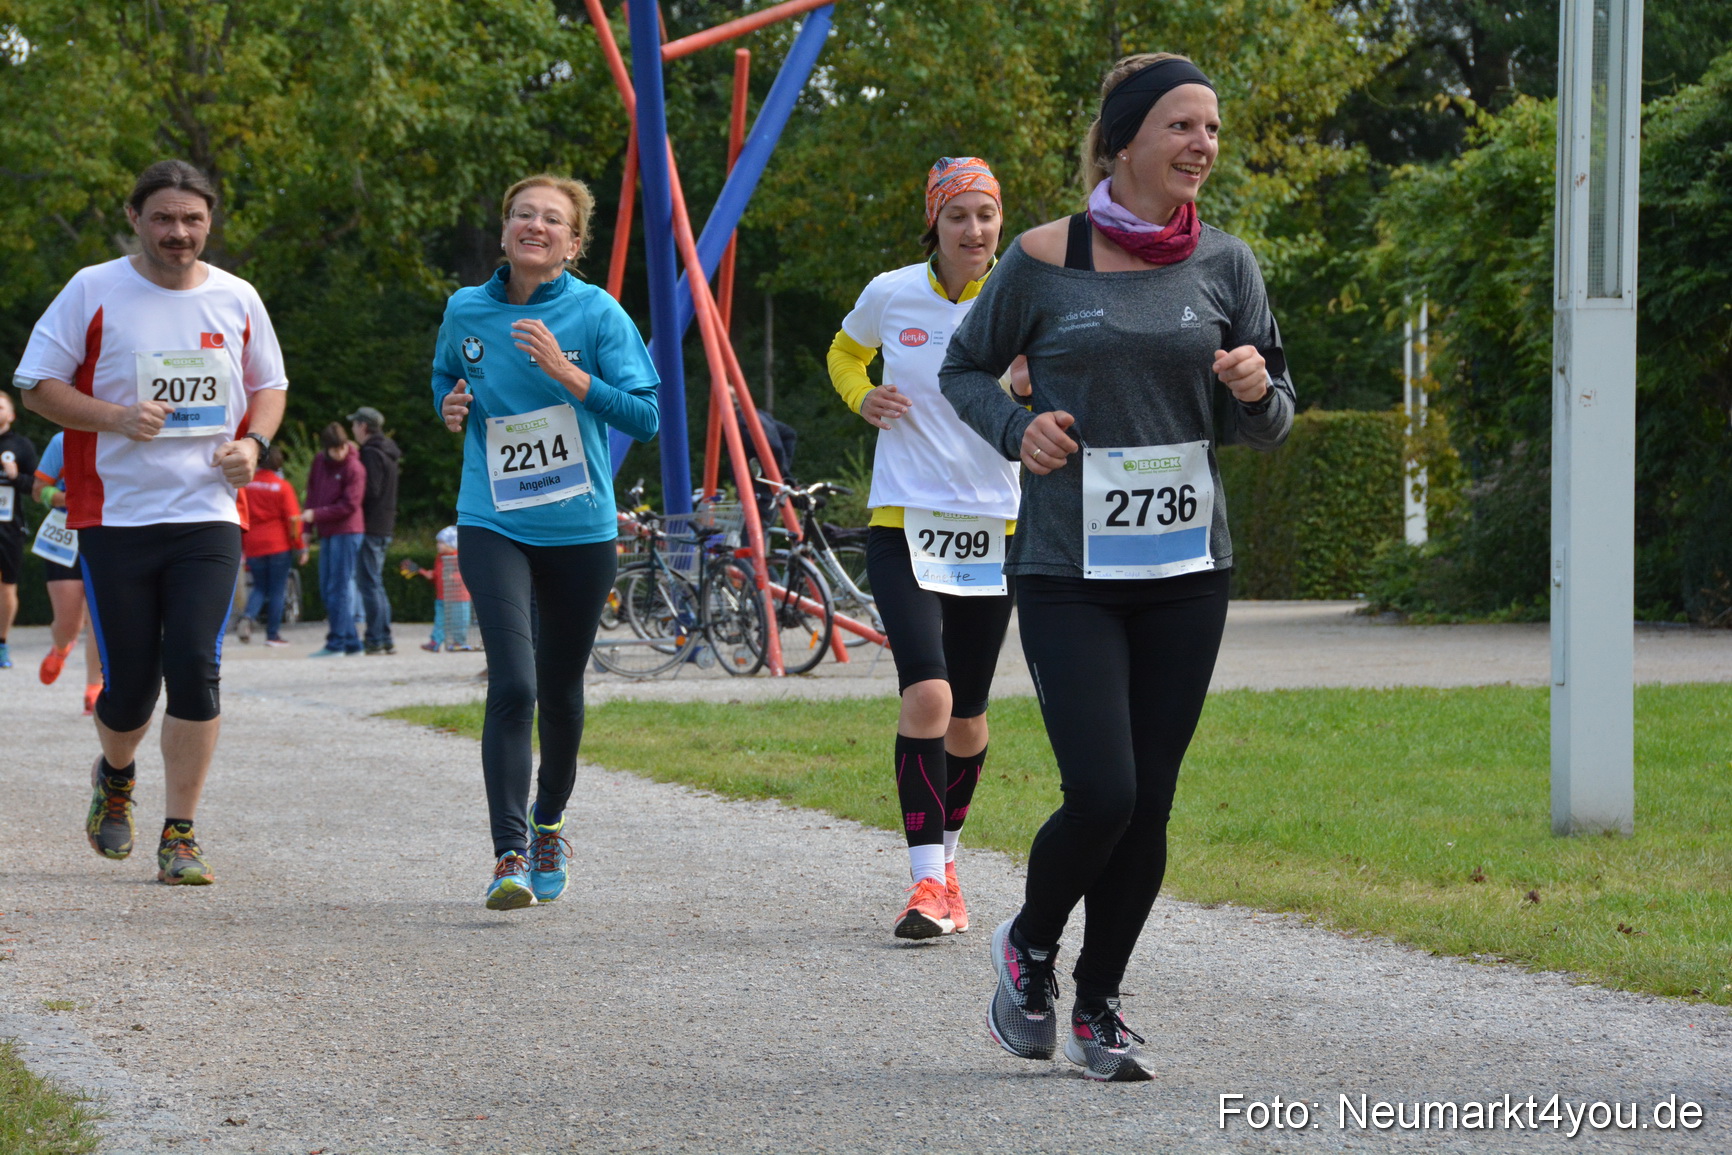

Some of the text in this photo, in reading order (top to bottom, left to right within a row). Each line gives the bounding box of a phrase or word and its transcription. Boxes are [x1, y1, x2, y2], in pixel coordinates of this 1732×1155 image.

[151, 376, 217, 403] 2073
[172, 412, 200, 422] Marco
[514, 417, 549, 432] BOCK
[500, 433, 569, 473] 2214
[1137, 456, 1182, 471] BOCK
[519, 475, 561, 491] Angelika
[1104, 483, 1198, 527] 2736
[42, 522, 74, 546] 2259
[1091, 522, 1097, 530] D
[918, 528, 990, 559] 2799
[922, 569, 977, 582] Annette
